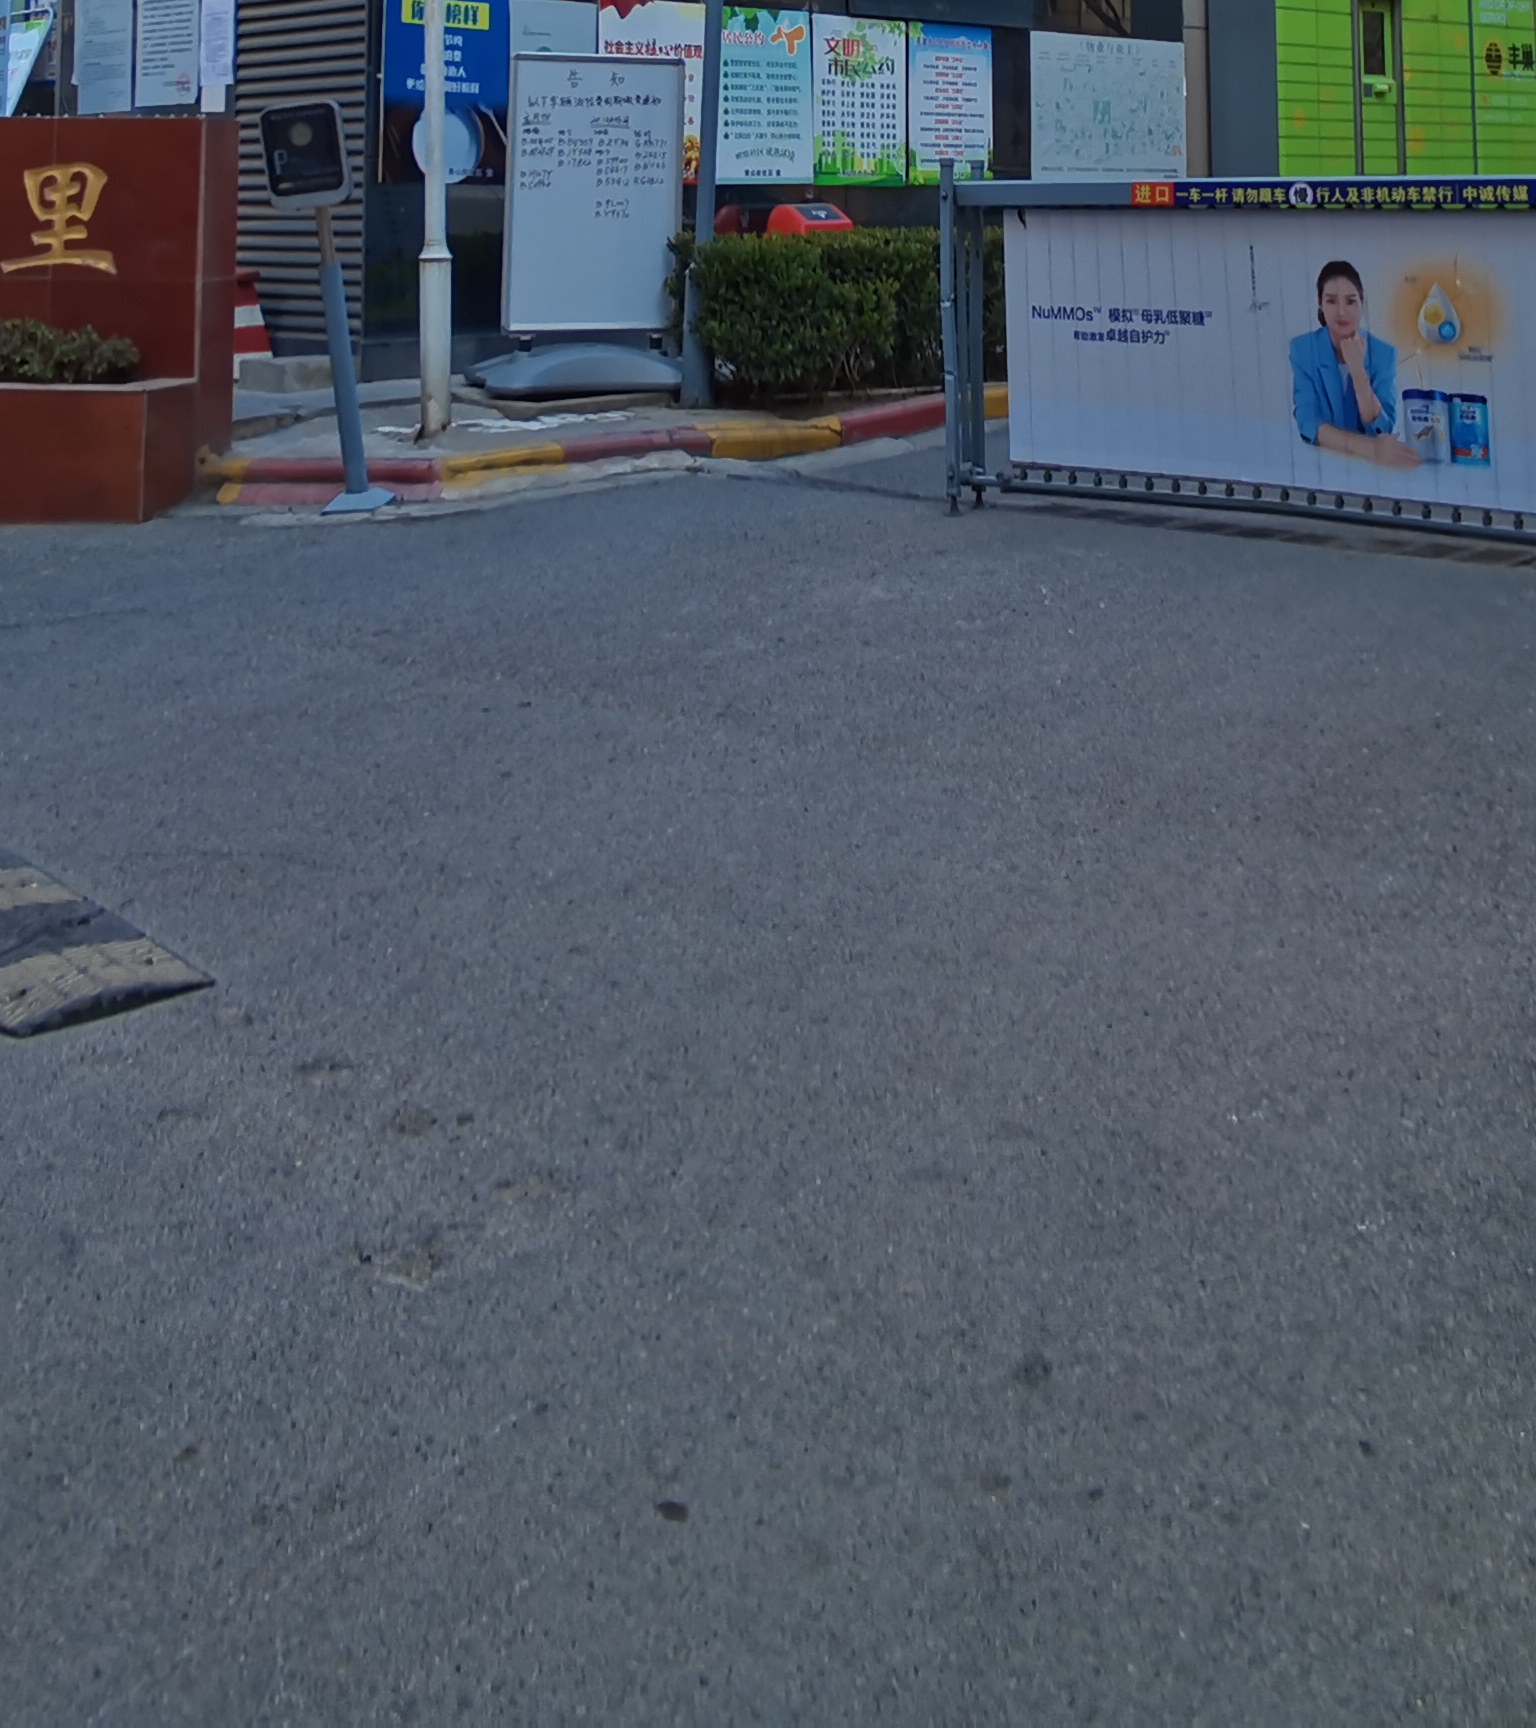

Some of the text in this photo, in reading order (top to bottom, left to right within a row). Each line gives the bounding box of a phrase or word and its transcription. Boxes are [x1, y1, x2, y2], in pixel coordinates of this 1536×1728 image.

[603, 38, 703, 59] 社会主义核心价值观
[823, 36, 862, 58] 文明
[1507, 42, 1535, 72] 丰巢
[826, 55, 896, 78] 市民公约
[1134, 185, 1171, 203] 进口
[1175, 187, 1229, 203] 一车一杆
[1231, 187, 1287, 204] 请勿跟车
[1315, 186, 1453, 204] 行人及非机动车禁行
[1462, 184, 1529, 203] 中诚传媒
